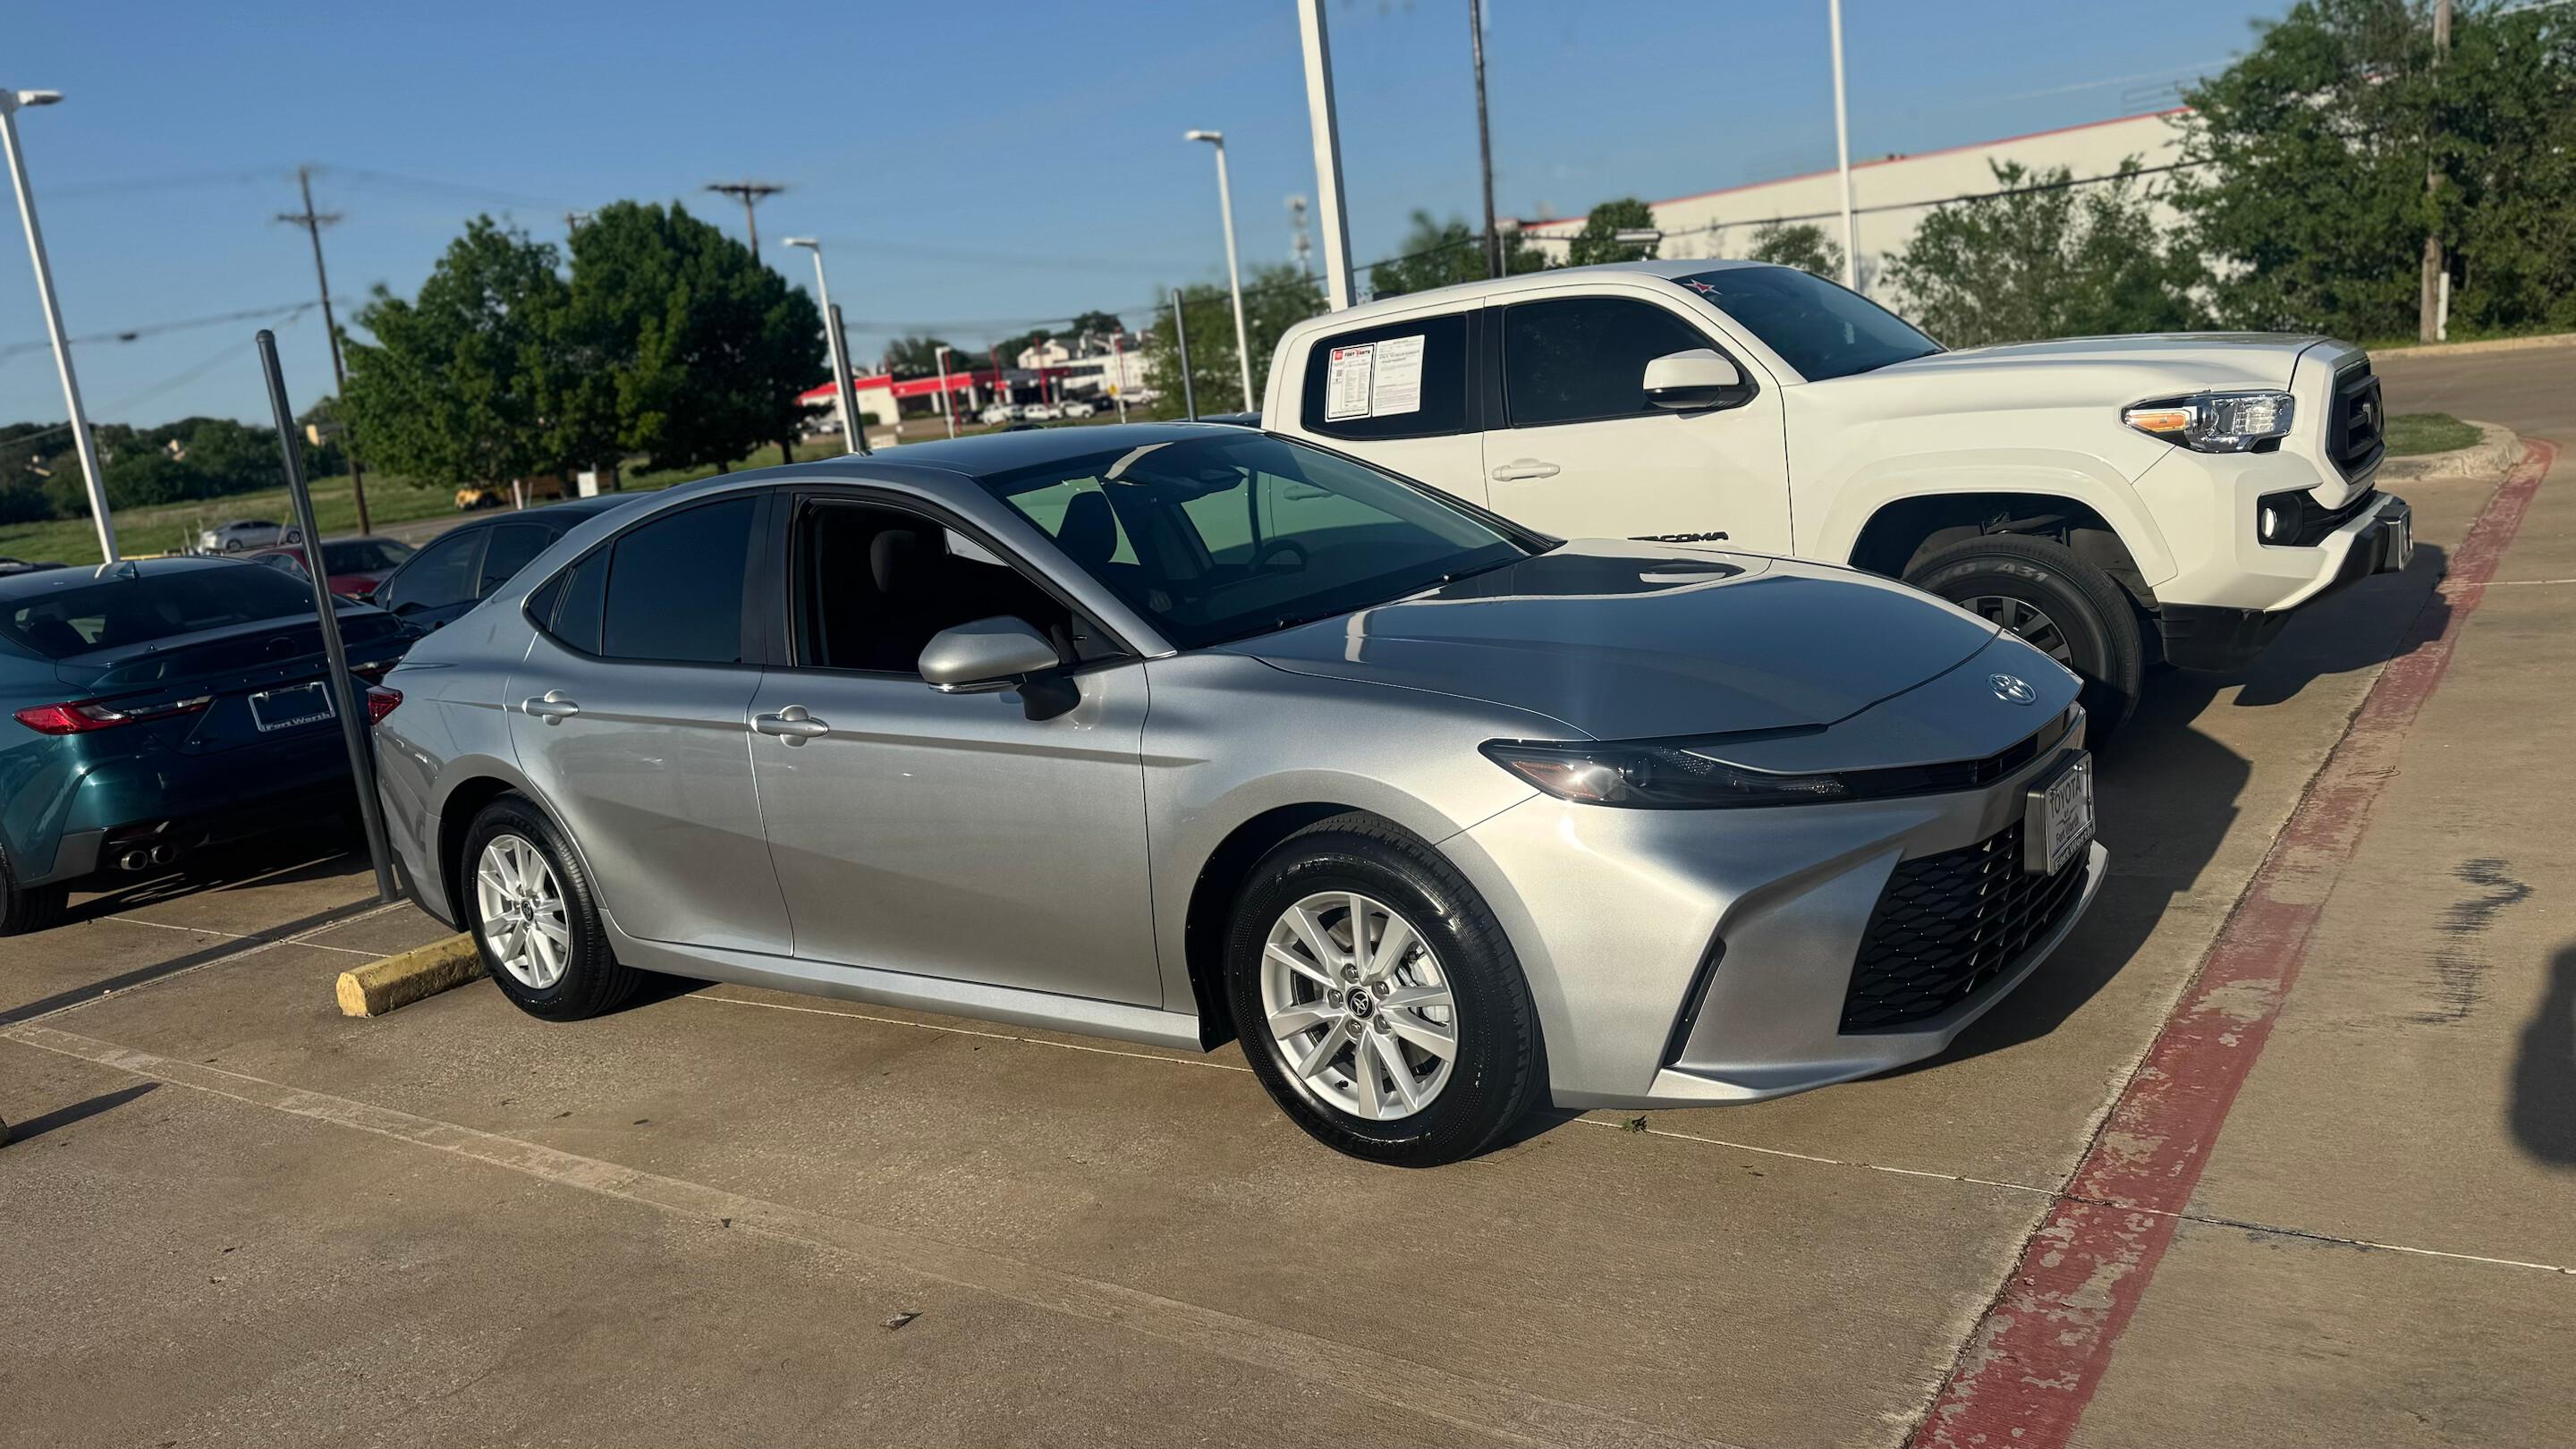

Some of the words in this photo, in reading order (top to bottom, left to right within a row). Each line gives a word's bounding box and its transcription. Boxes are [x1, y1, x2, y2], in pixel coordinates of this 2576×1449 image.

[1995, 562, 2049, 582] A31
[266, 720, 292, 731] Fort
[292, 713, 331, 724] Worth
[2050, 774, 2081, 818] TOYOTA
[2055, 846, 2070, 870] Fort
[2070, 823, 2095, 853] Worth
